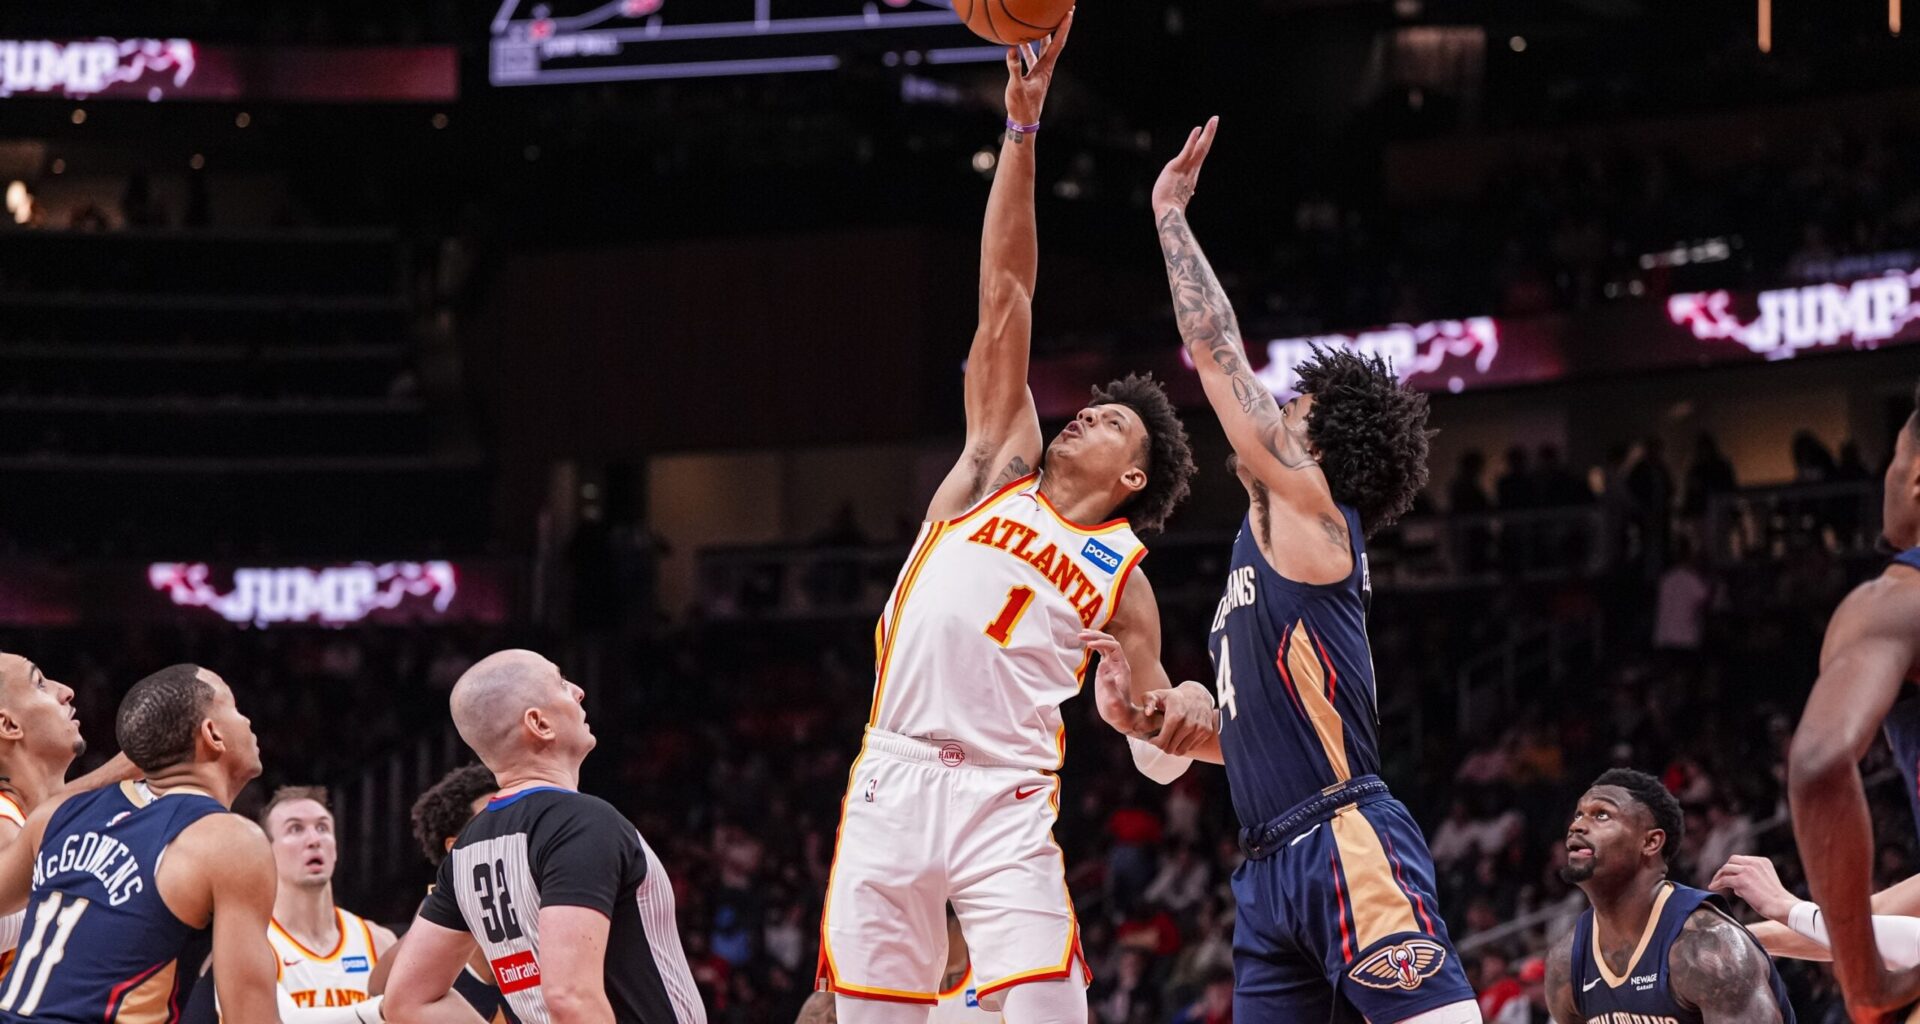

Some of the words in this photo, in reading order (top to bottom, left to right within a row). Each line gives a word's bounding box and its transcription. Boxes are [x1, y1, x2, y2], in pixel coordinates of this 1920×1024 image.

[1747, 274, 1911, 353] JUMP
[968, 516, 1105, 629] ATLANTA
[1085, 542, 1119, 568] paze
[223, 567, 377, 622] JUMP
[982, 584, 1036, 648] 1
[938, 750, 966, 761] HAWKS
[472, 858, 524, 944] 32
[0, 891, 90, 1017] 11
[498, 960, 541, 984] Emirates
[1631, 973, 1658, 985] NEWAGE
